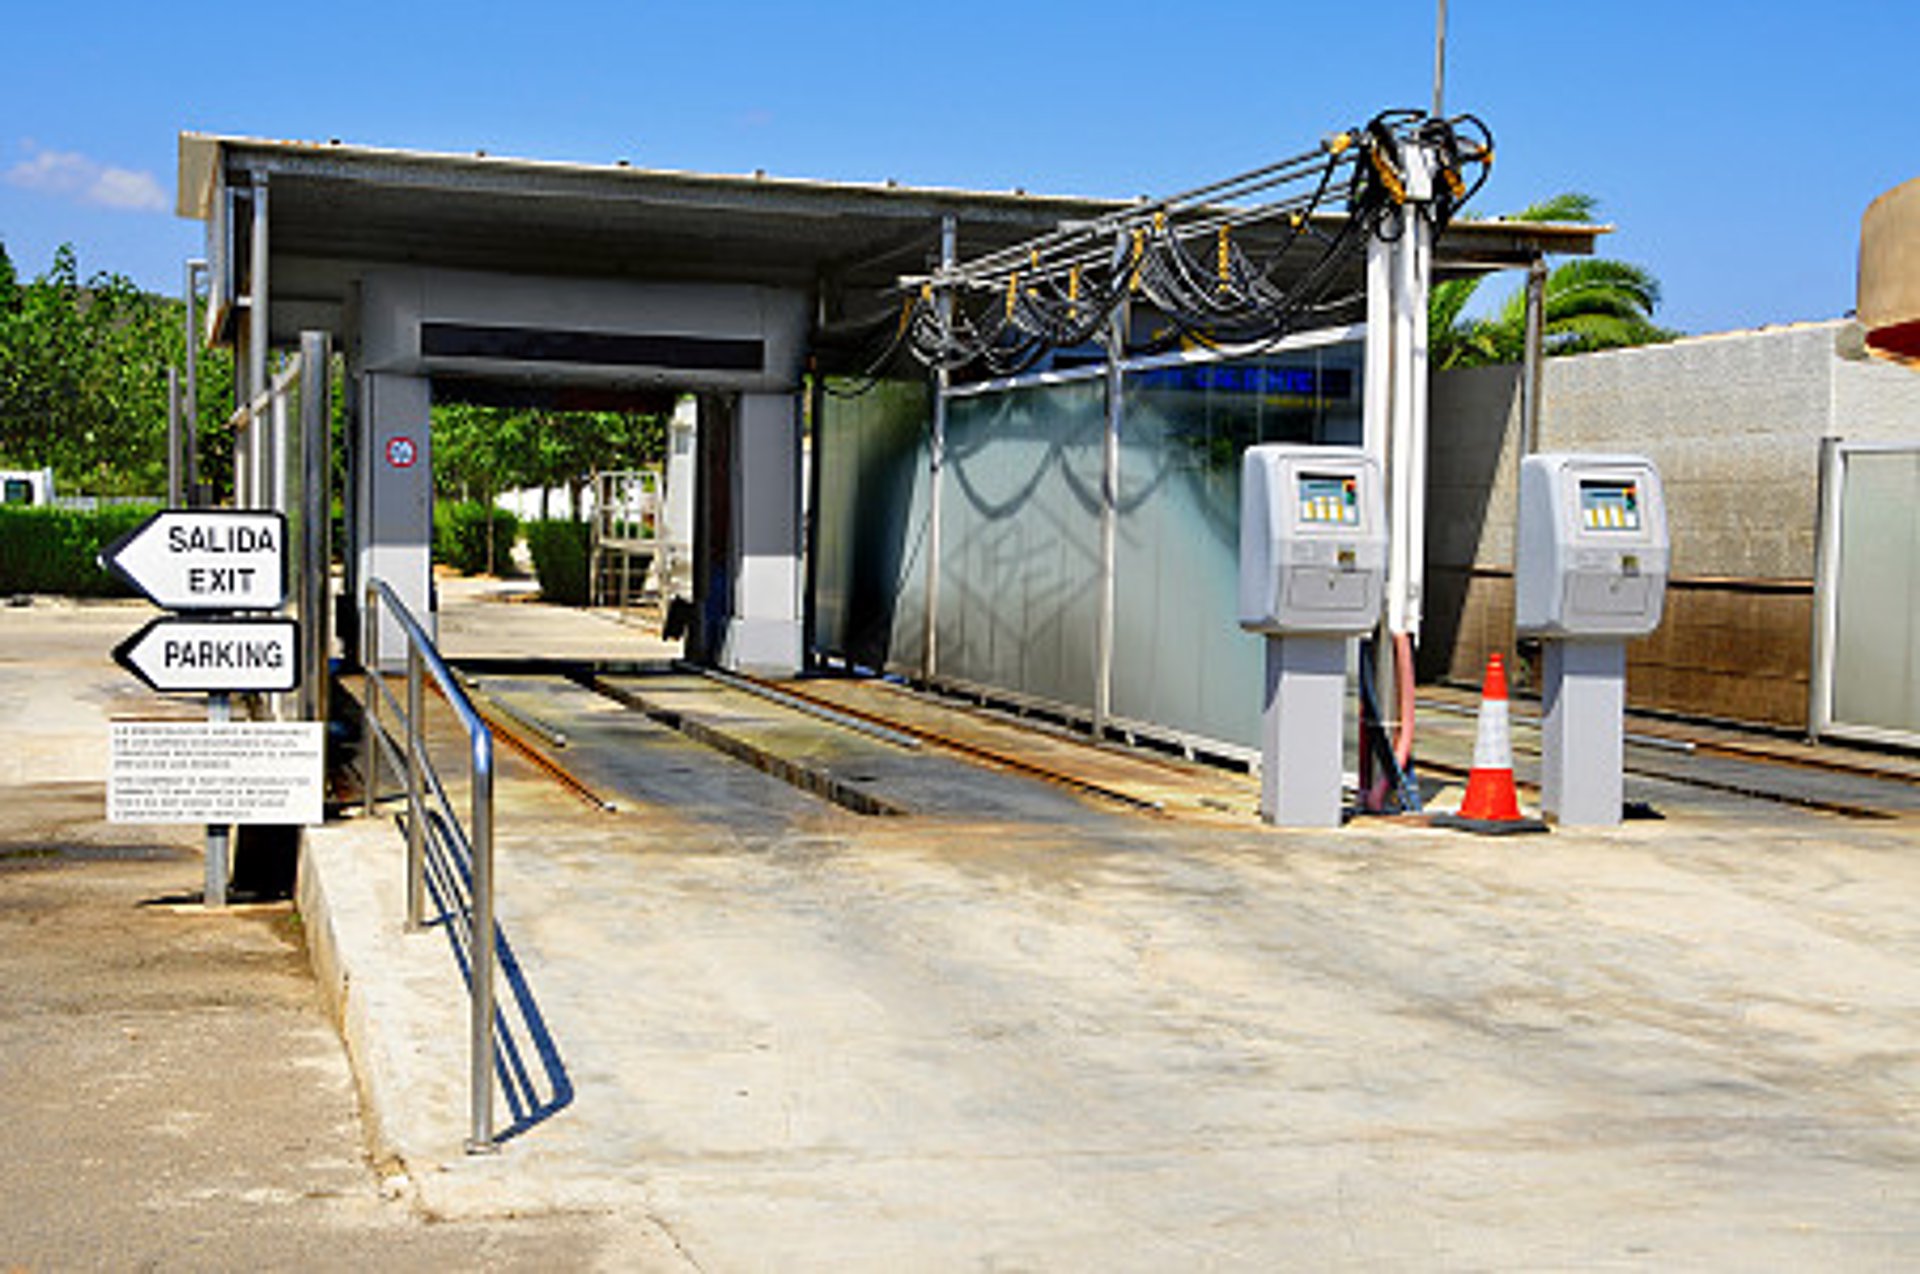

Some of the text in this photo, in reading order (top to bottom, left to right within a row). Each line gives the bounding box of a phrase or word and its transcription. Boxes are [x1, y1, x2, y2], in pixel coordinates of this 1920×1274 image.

[168, 526, 277, 553] SALIDA
[189, 568, 255, 592] EXIT
[164, 640, 283, 669] PARKING
